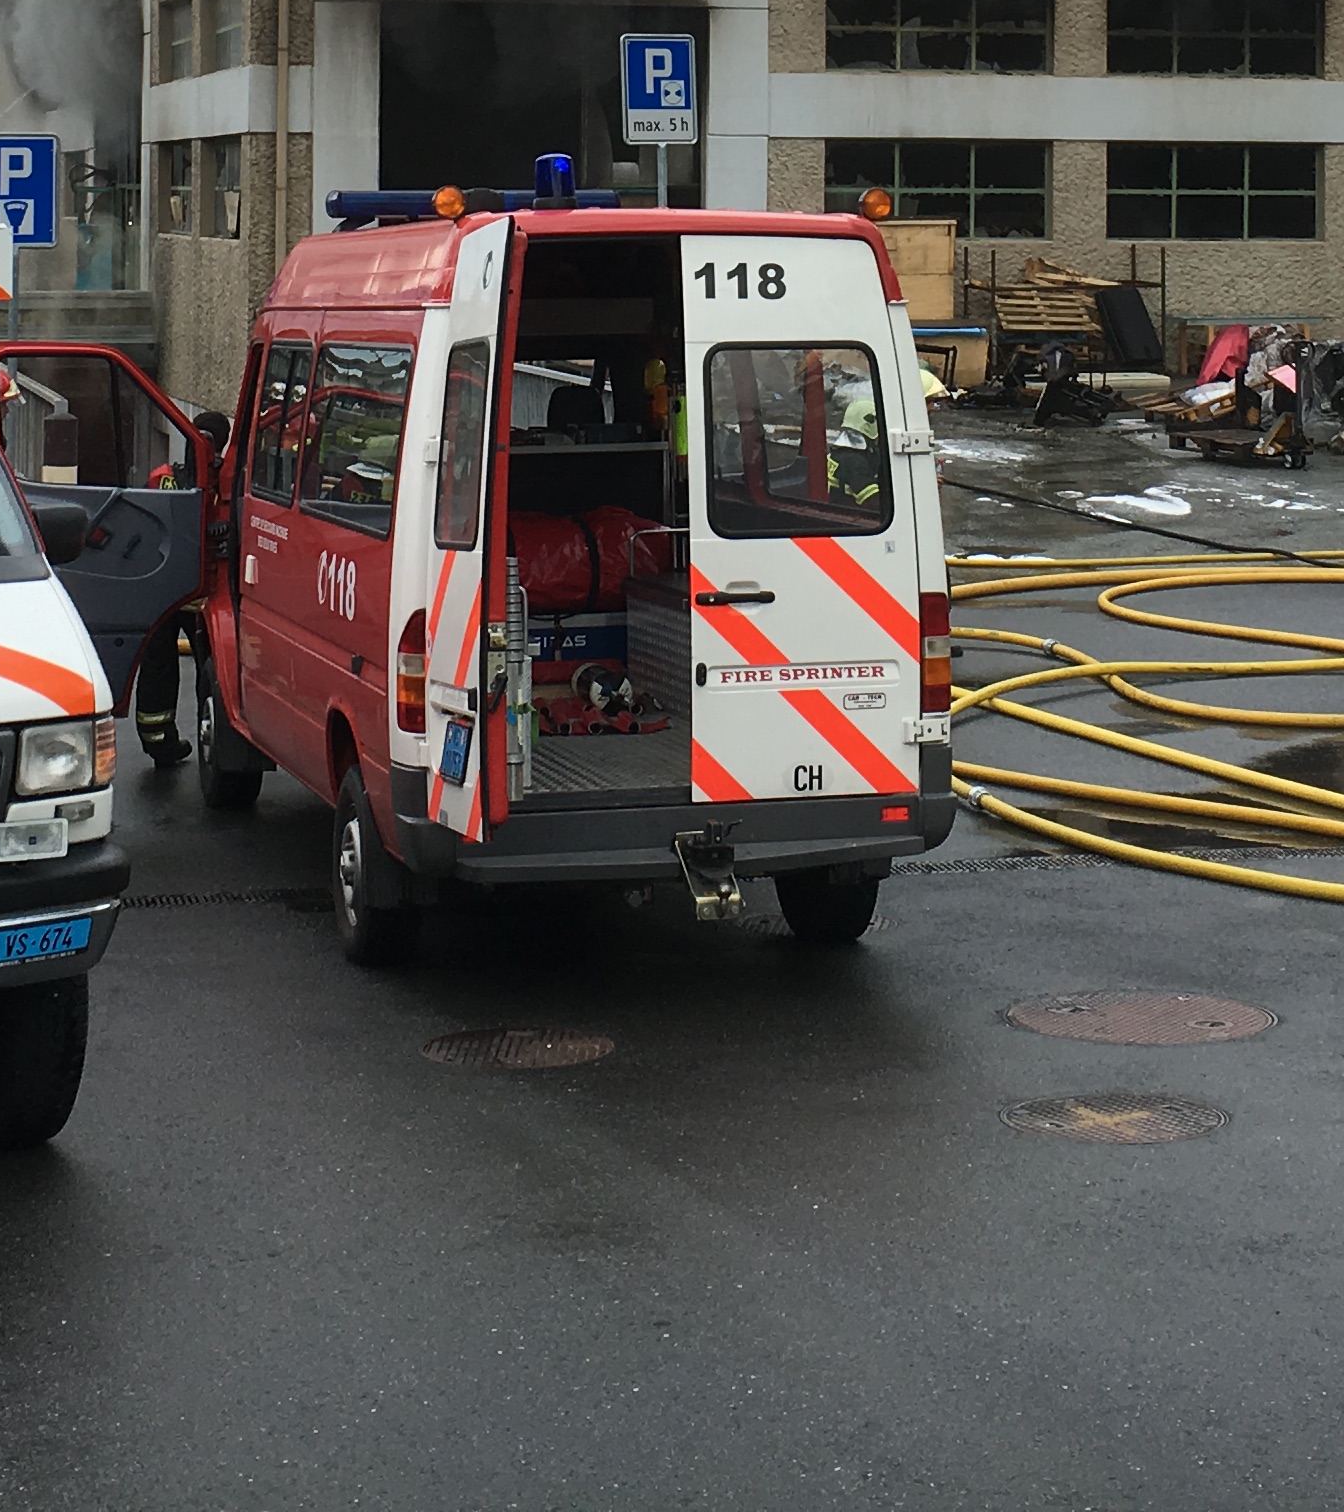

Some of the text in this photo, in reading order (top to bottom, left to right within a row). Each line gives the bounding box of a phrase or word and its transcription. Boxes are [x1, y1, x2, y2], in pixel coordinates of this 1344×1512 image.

[645, 48, 673, 94] P
[633, 117, 689, 132] max. 5 h
[0, 147, 33, 196] P
[694, 262, 787, 300] 118
[328, 553, 356, 622] 118
[720, 666, 886, 684] FIRE SPRINTER
[794, 764, 823, 792] CH
[6, 925, 73, 957] VS 674
